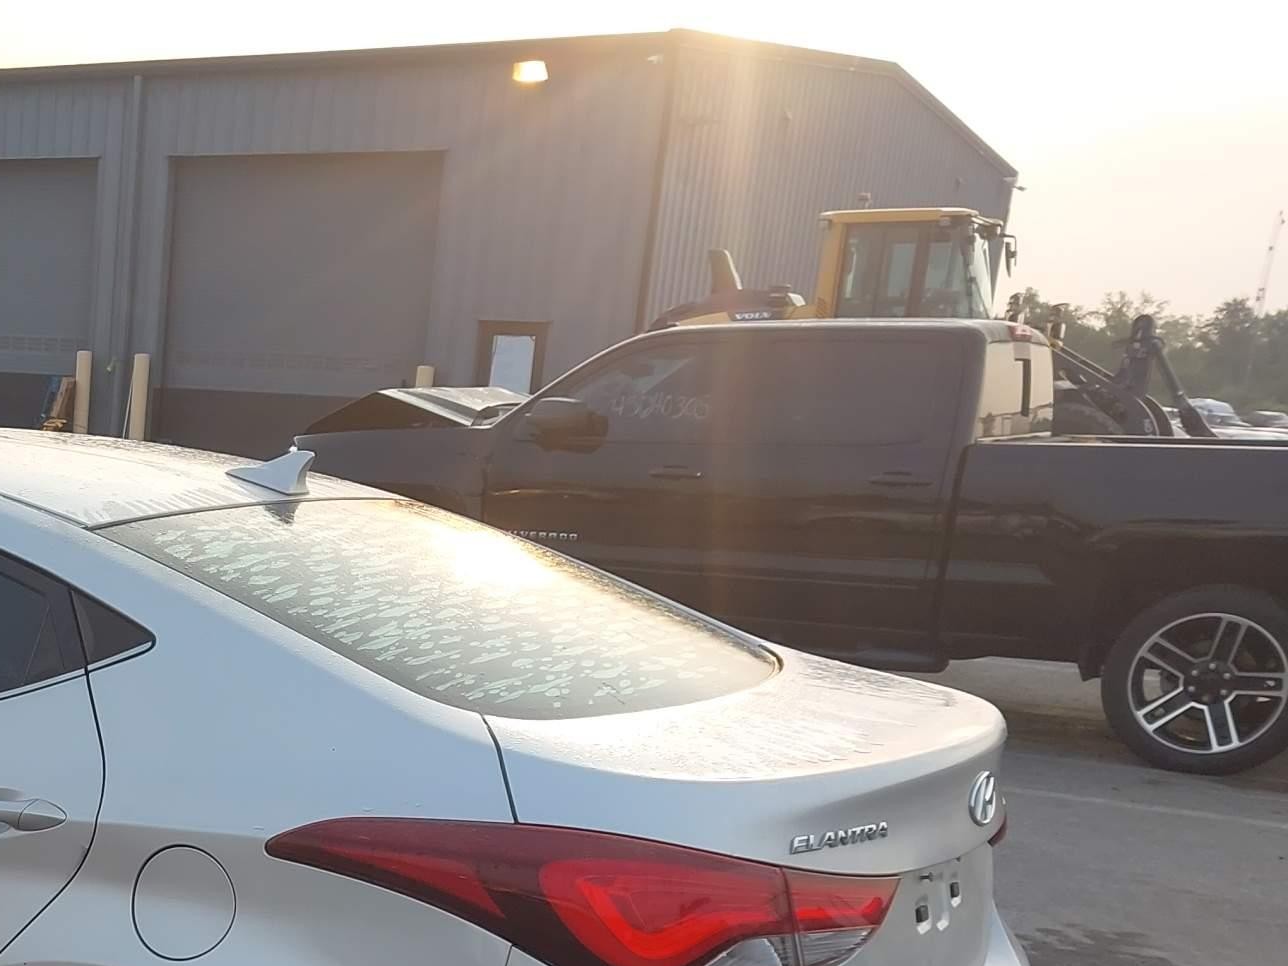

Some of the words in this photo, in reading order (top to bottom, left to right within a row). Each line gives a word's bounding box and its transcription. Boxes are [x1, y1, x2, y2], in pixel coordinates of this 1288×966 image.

[735, 311, 772, 320] VOLV
[509, 530, 578, 540] VERADO
[790, 821, 888, 855] ELANTRA
